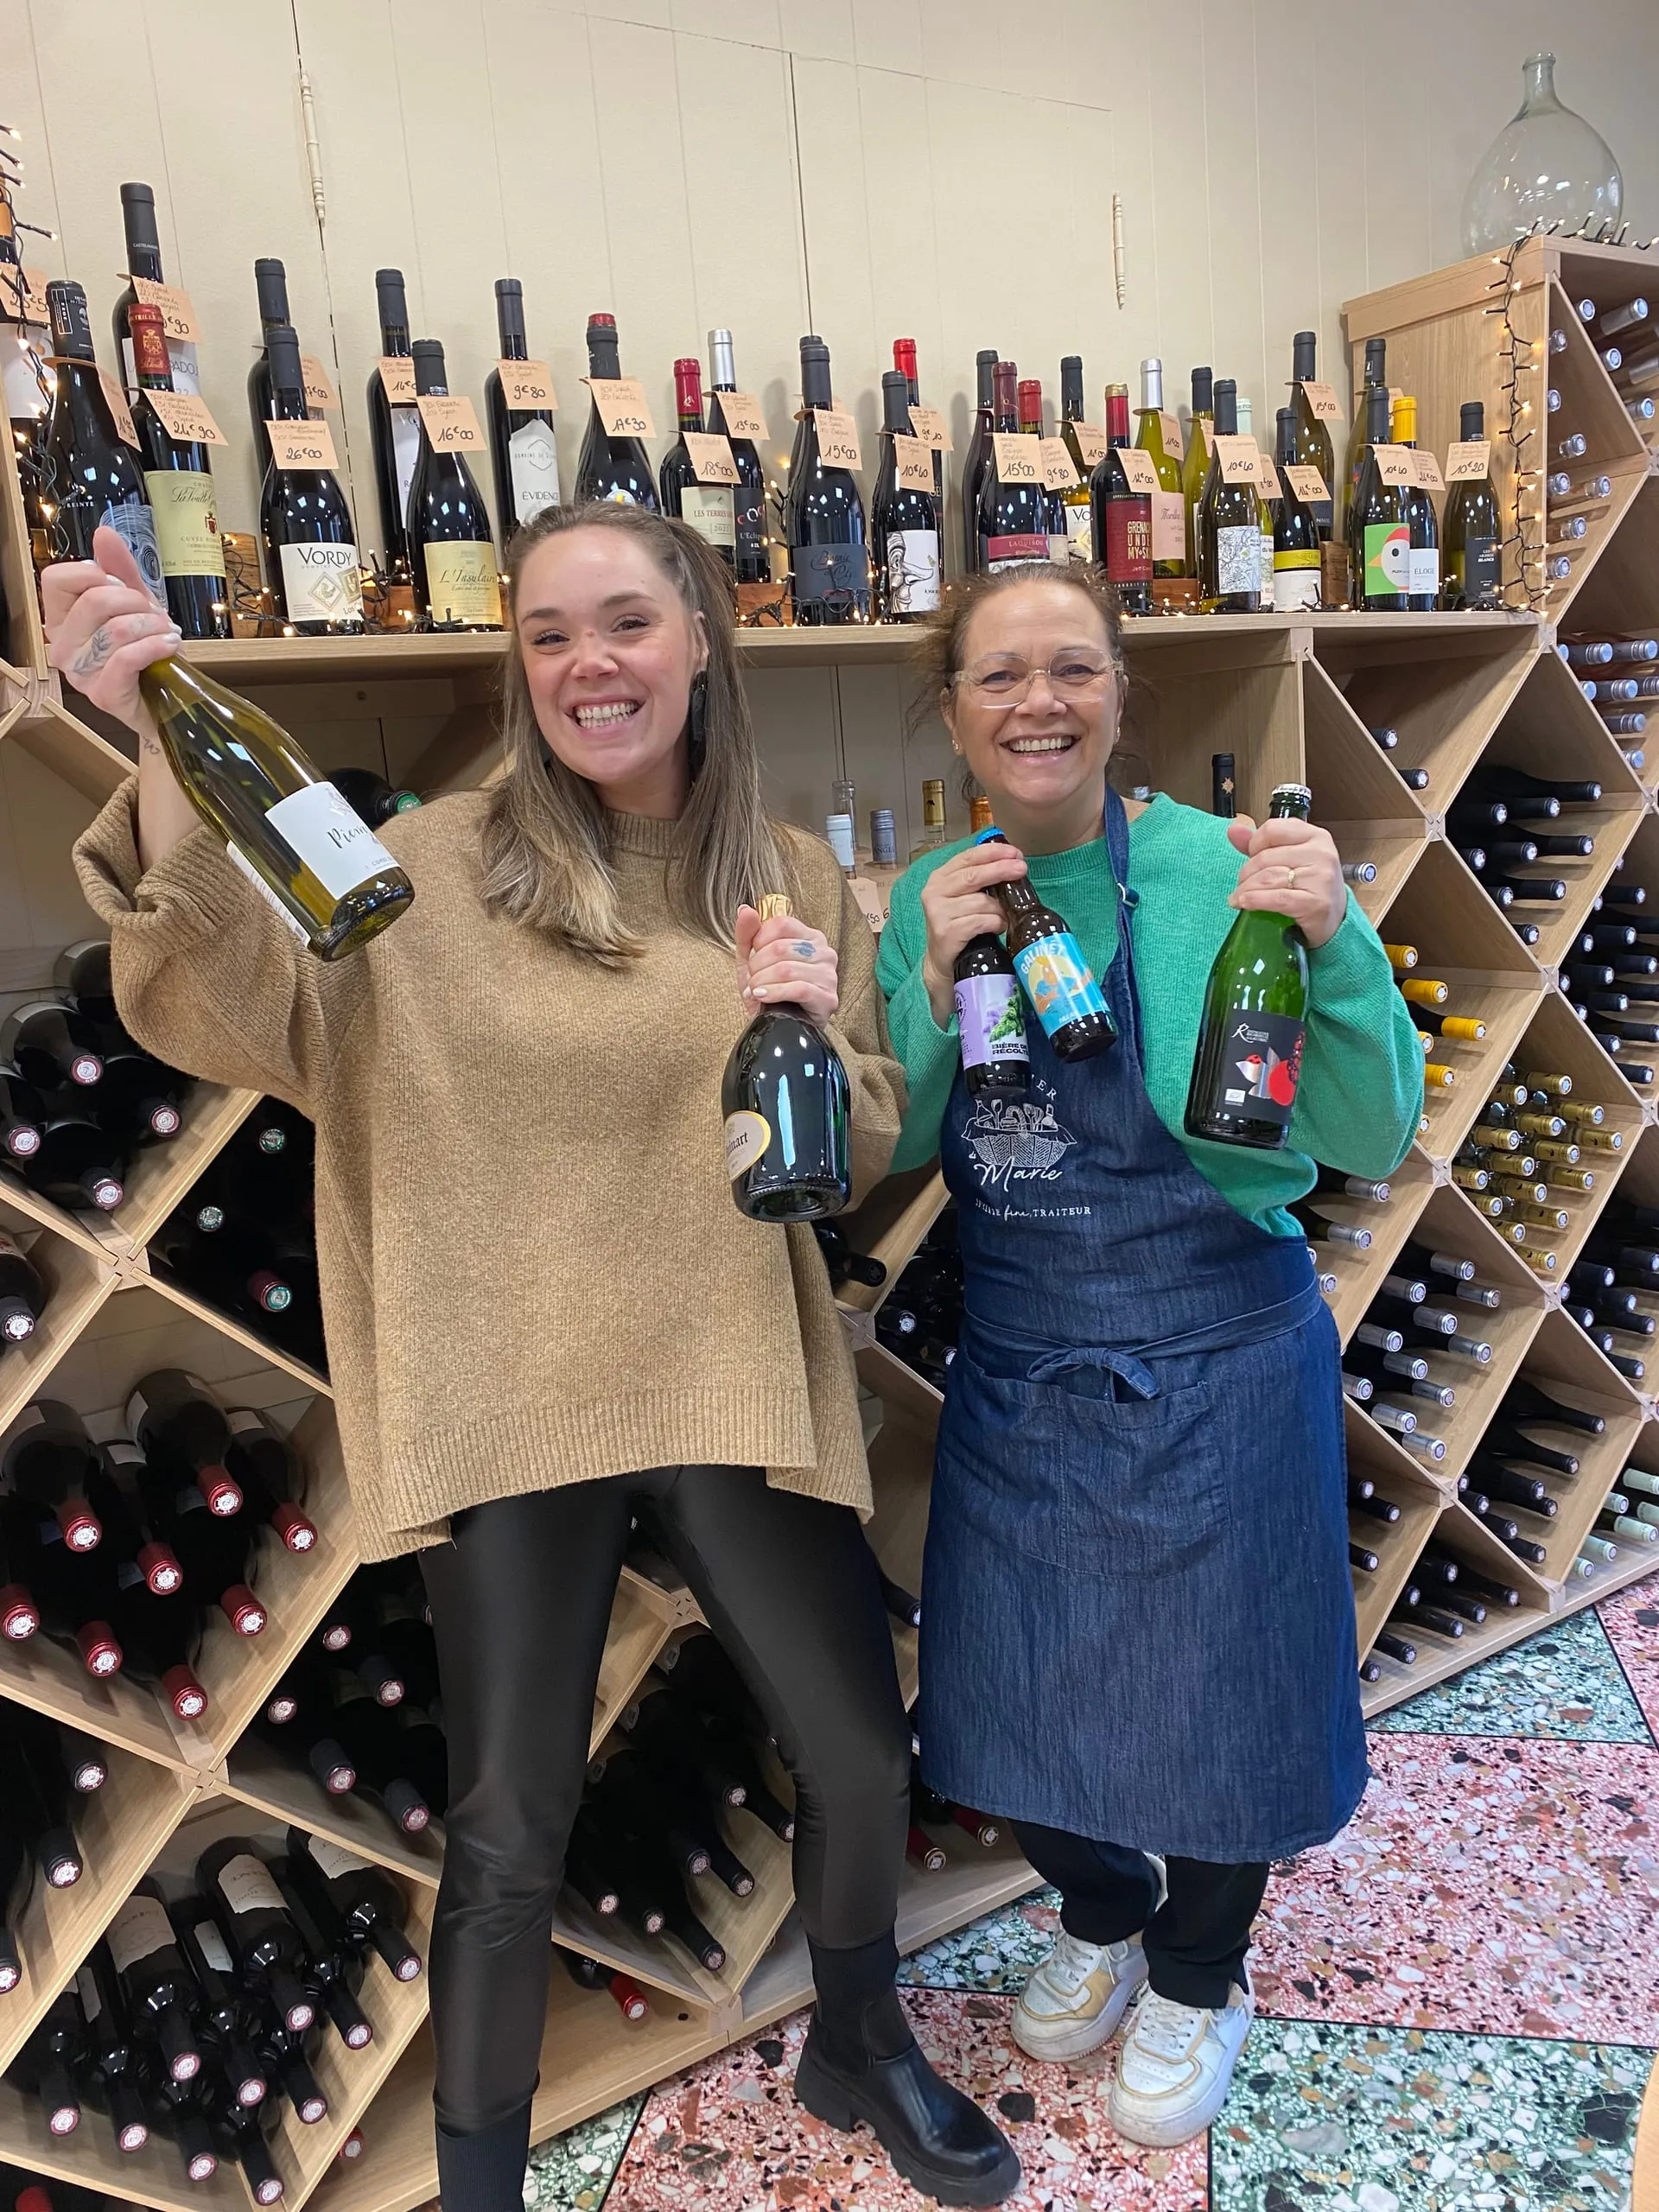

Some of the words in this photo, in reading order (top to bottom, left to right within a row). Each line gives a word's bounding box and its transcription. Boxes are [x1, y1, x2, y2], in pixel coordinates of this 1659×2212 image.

[513, 385, 546, 400] 9€80
[437, 426, 474, 442] 16€00
[285, 448, 323, 460] 26€00
[824, 444, 857, 460] 15€00
[1001, 461, 1035, 478] 15€00
[1046, 467, 1070, 484] 9€80
[1451, 461, 1484, 476] 10€20
[297, 547, 352, 569] VORDY
[991, 1041, 1019, 1050] BIÈRE
[973, 1156, 1063, 1192] Marie
[1033, 1206, 1091, 1217] TRAITEUR
